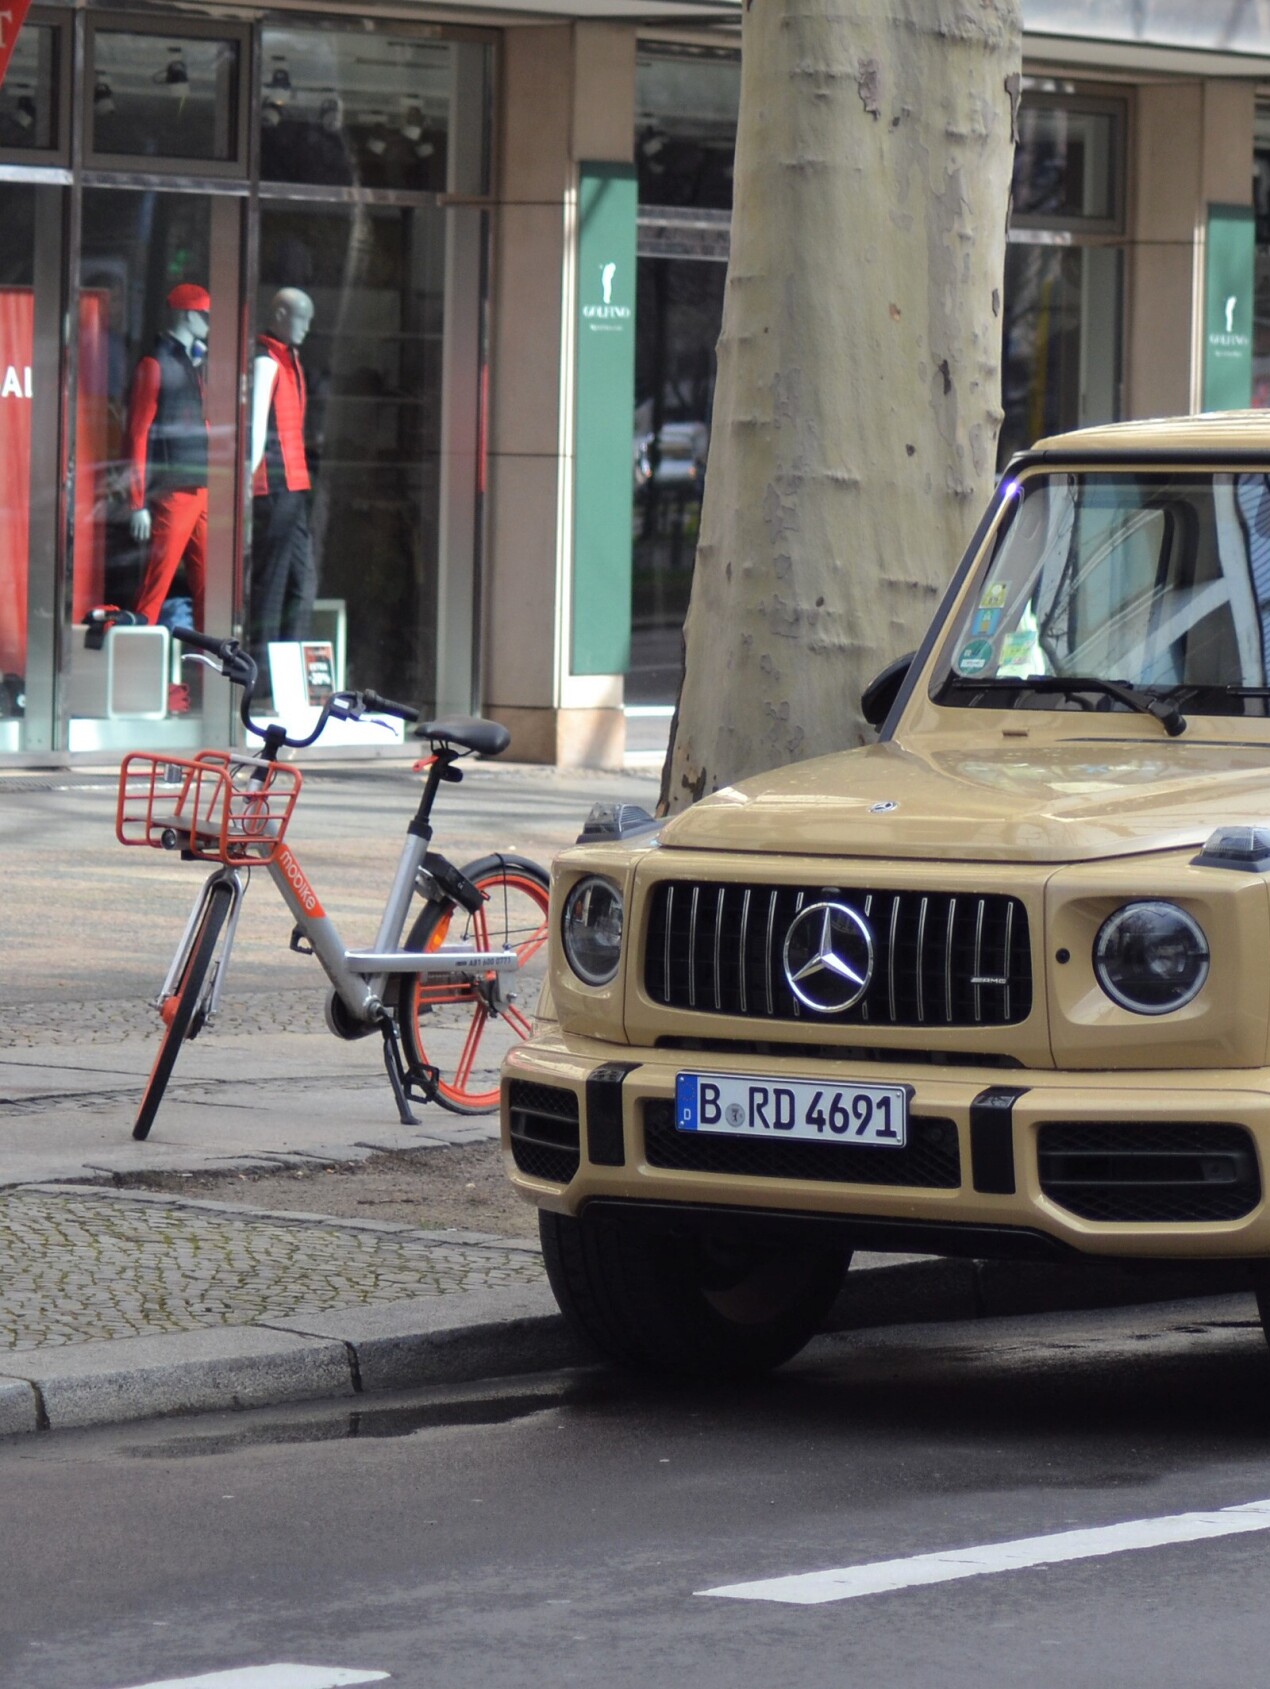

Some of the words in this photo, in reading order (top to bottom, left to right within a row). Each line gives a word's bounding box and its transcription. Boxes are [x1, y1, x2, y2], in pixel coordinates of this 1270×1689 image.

[280, 851, 316, 910] mobike
[683, 1108, 692, 1121] D
[700, 1083, 722, 1124] B
[749, 1086, 796, 1130] RD
[805, 1091, 897, 1138] 4691
